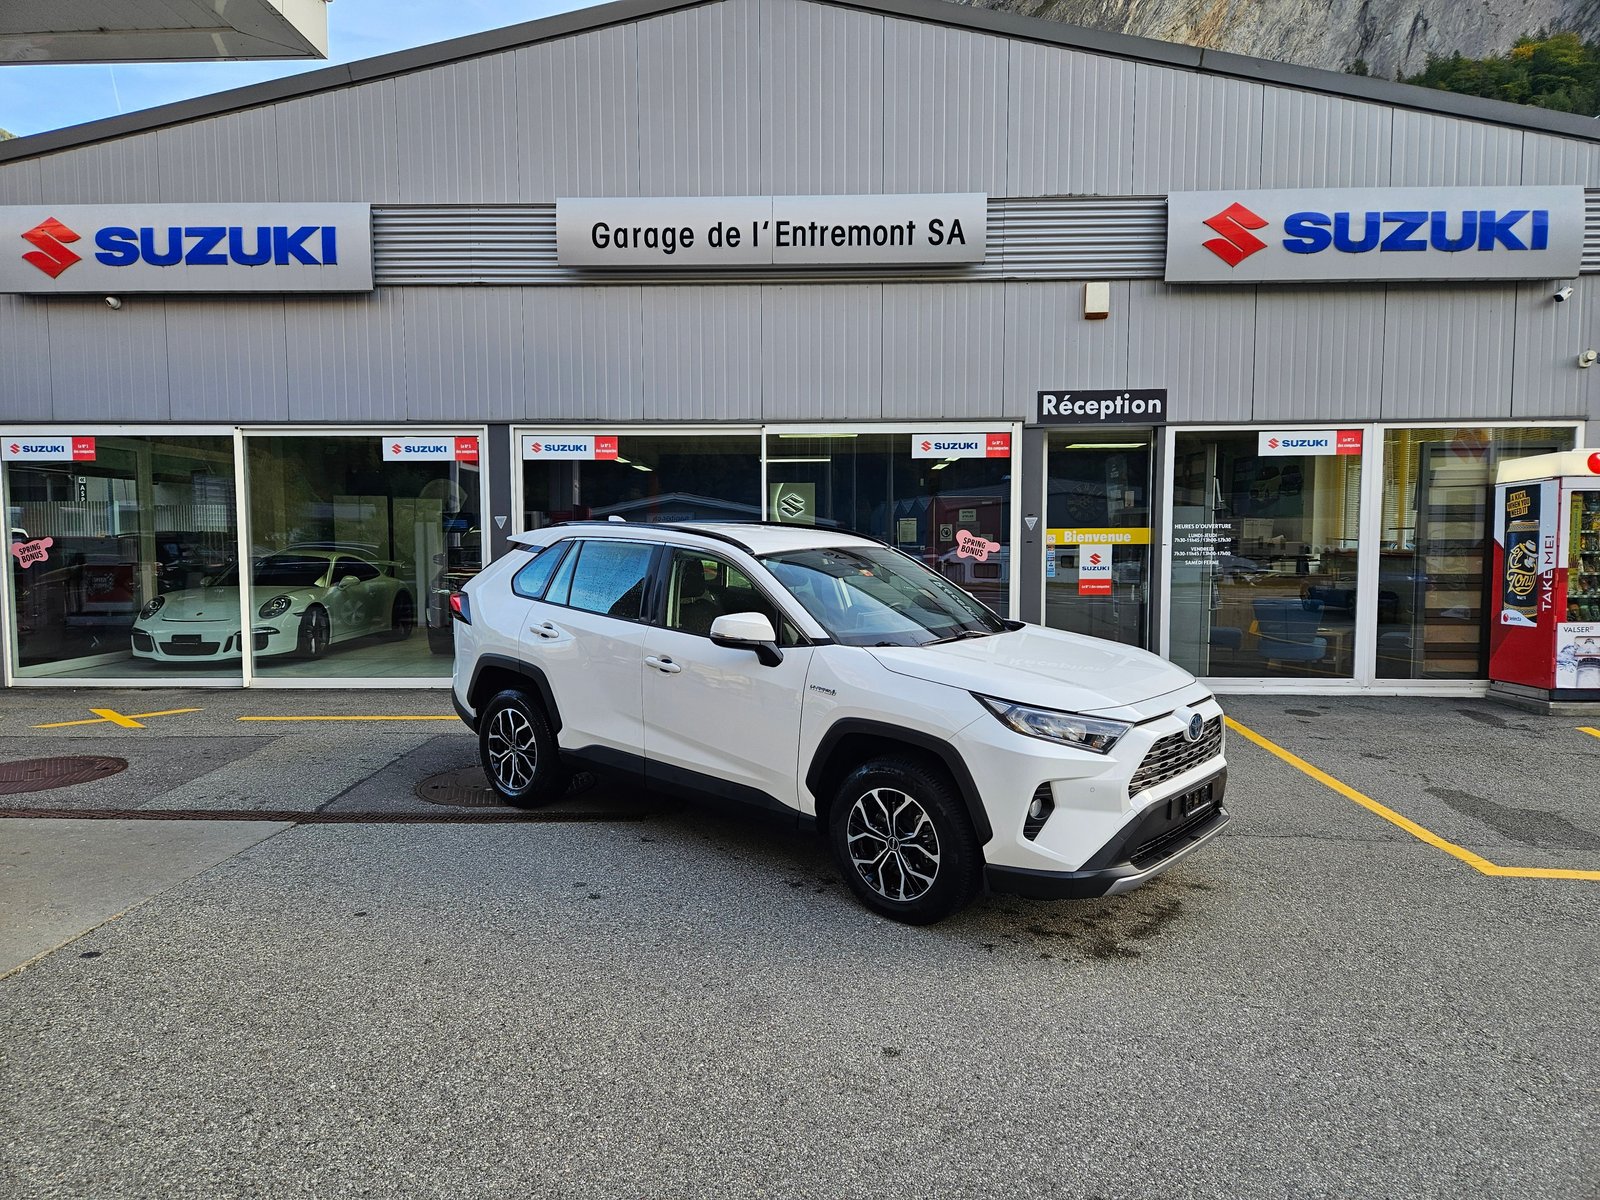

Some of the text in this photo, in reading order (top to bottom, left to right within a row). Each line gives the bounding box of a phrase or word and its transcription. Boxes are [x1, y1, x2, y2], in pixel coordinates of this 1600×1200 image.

[592, 221, 695, 254] Garage
[708, 221, 741, 248] de
[928, 217, 967, 246] SA
[1282, 209, 1549, 254] SUZUKI
[94, 226, 338, 267] SUZUKI
[1042, 392, 1162, 420] Réception
[22, 445, 65, 453] SUZUKI
[404, 445, 447, 453] SUZUKI
[544, 444, 587, 452] SUZUKI
[934, 442, 978, 450] SUZUKI
[1281, 439, 1328, 448] SUZUKI
[1063, 530, 1131, 543] Bienvenue
[18, 543, 41, 555] SPRING
[963, 537, 986, 549] SPRING
[21, 551, 44, 563] BONUS
[960, 545, 984, 557] BONUS
[1542, 535, 1554, 611] TAKE ME!
